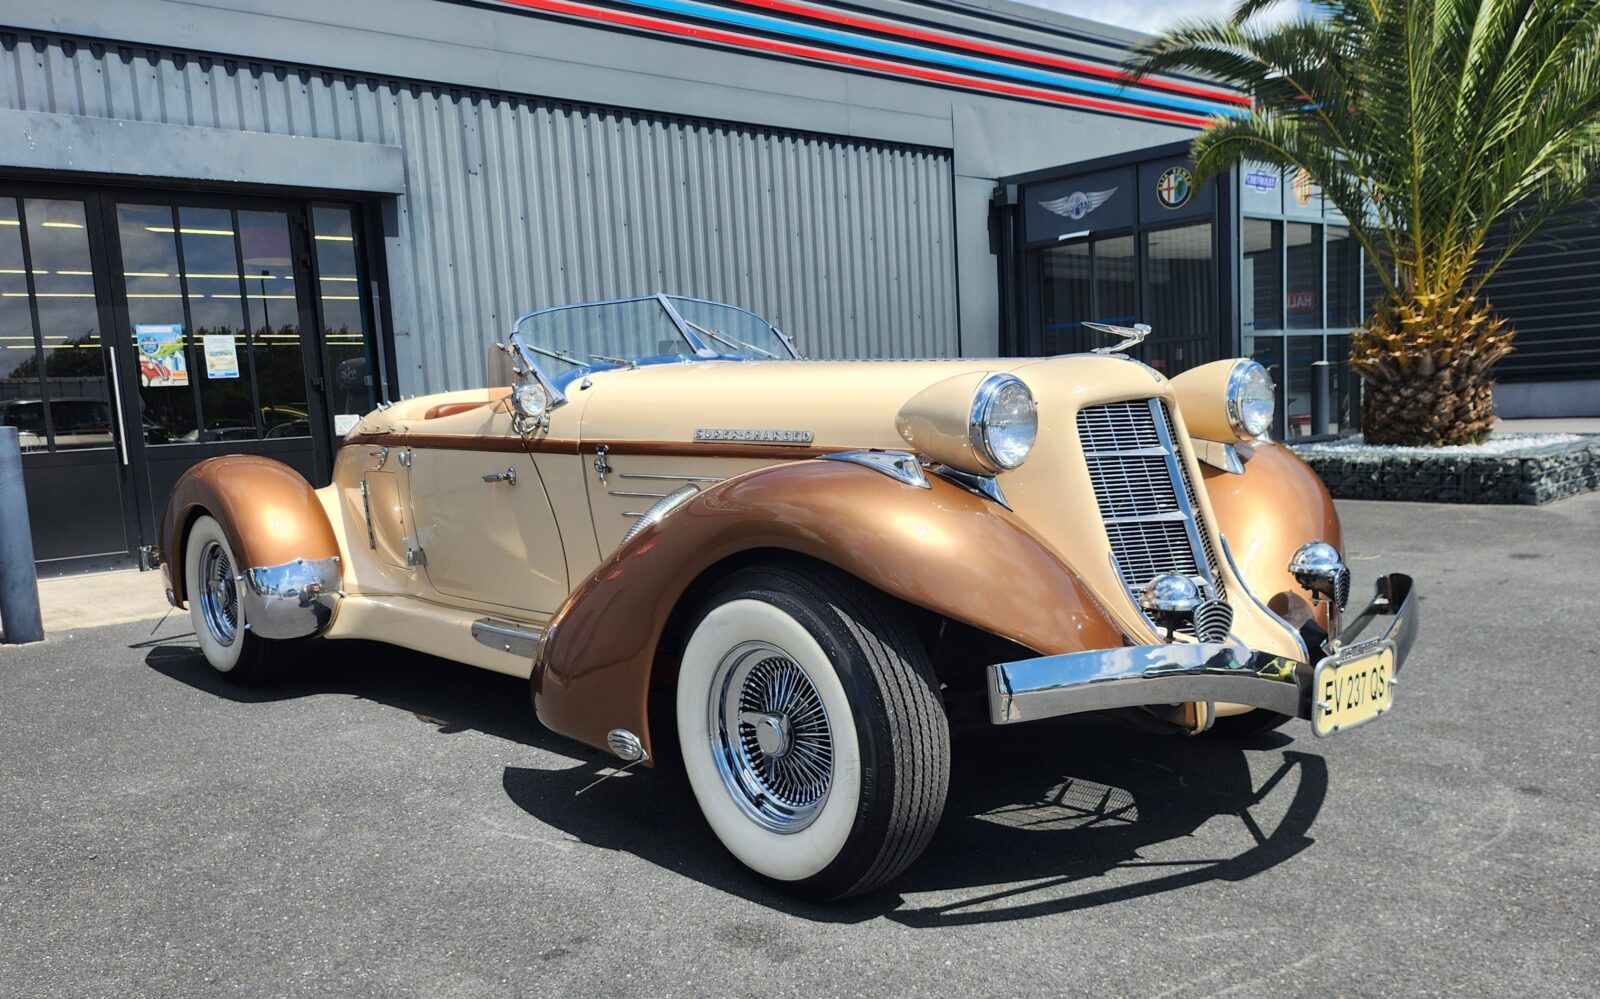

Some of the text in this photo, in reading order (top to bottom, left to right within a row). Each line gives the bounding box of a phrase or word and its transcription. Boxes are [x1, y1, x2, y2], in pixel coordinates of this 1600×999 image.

[1325, 664, 1385, 716] EV 237 QS
